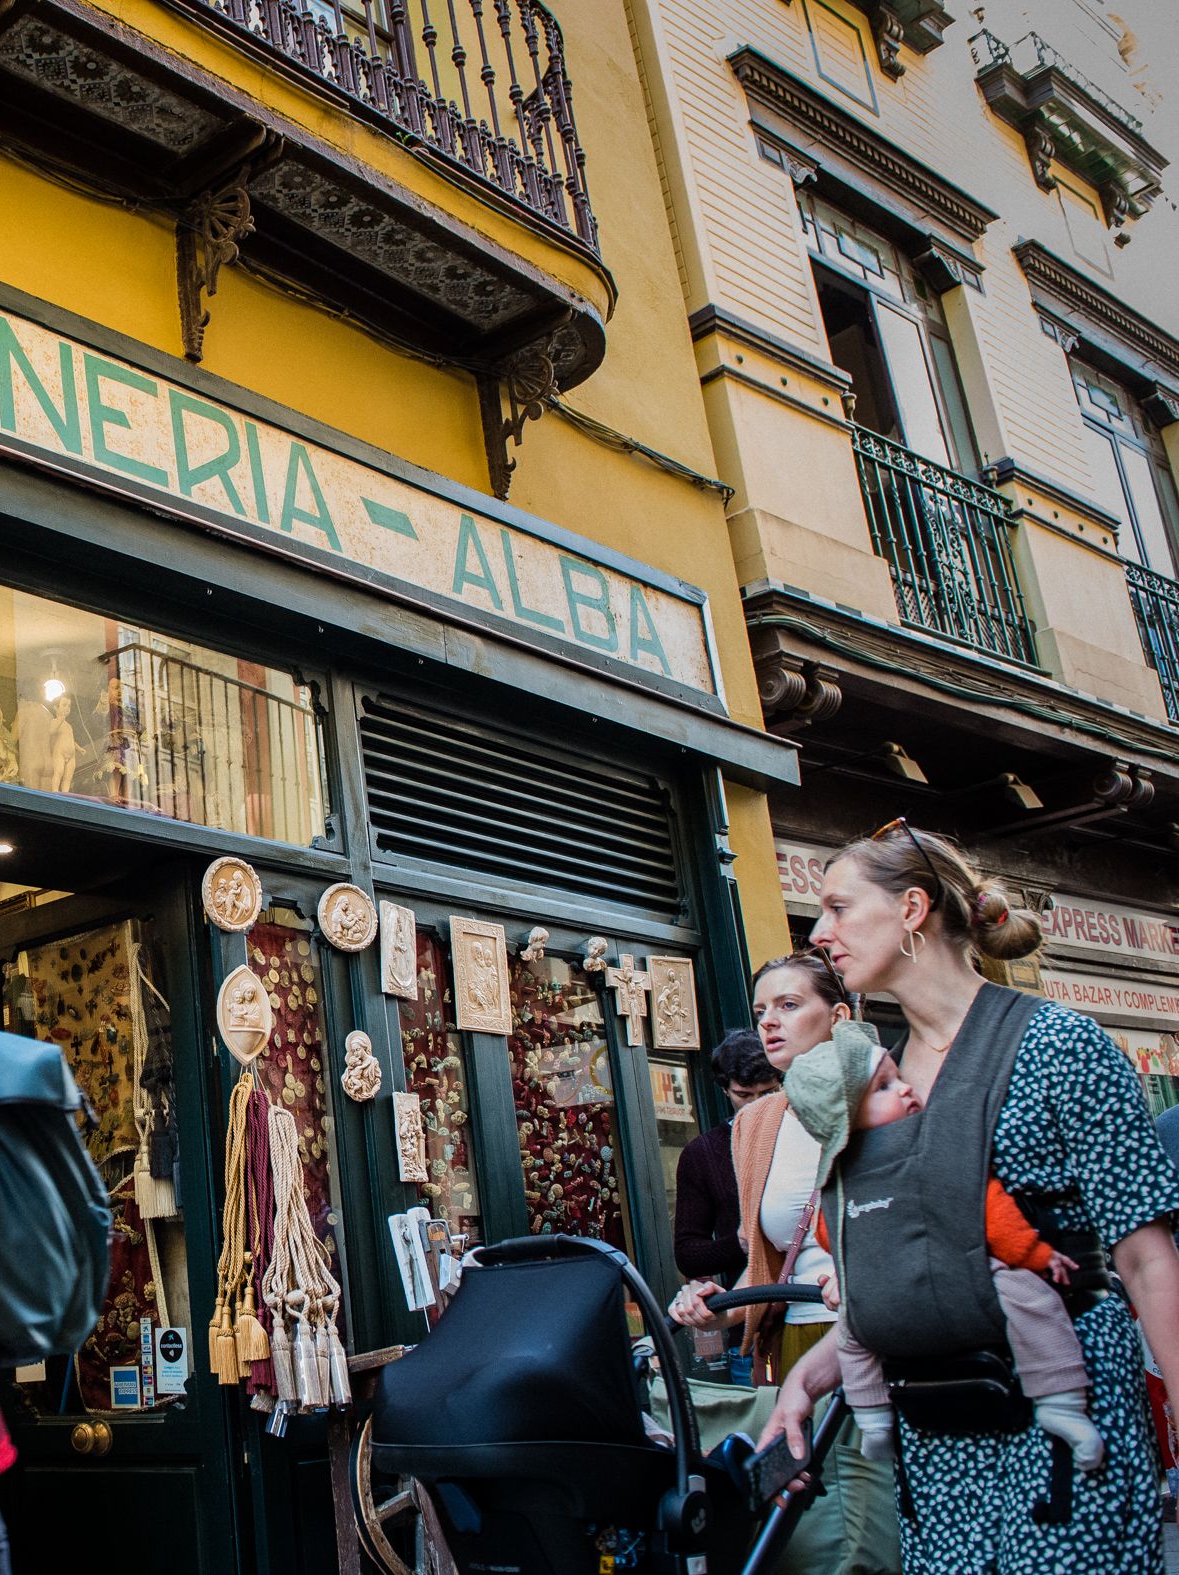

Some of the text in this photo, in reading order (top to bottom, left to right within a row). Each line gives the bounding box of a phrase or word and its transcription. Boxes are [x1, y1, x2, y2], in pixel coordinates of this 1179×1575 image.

[452, 514, 672, 676] ALBA
[1040, 905, 1123, 946] EXPRESS
[1044, 980, 1071, 1000] UTA
[1073, 983, 1114, 1006] BAZAR
[1114, 988, 1122, 1007] Y
